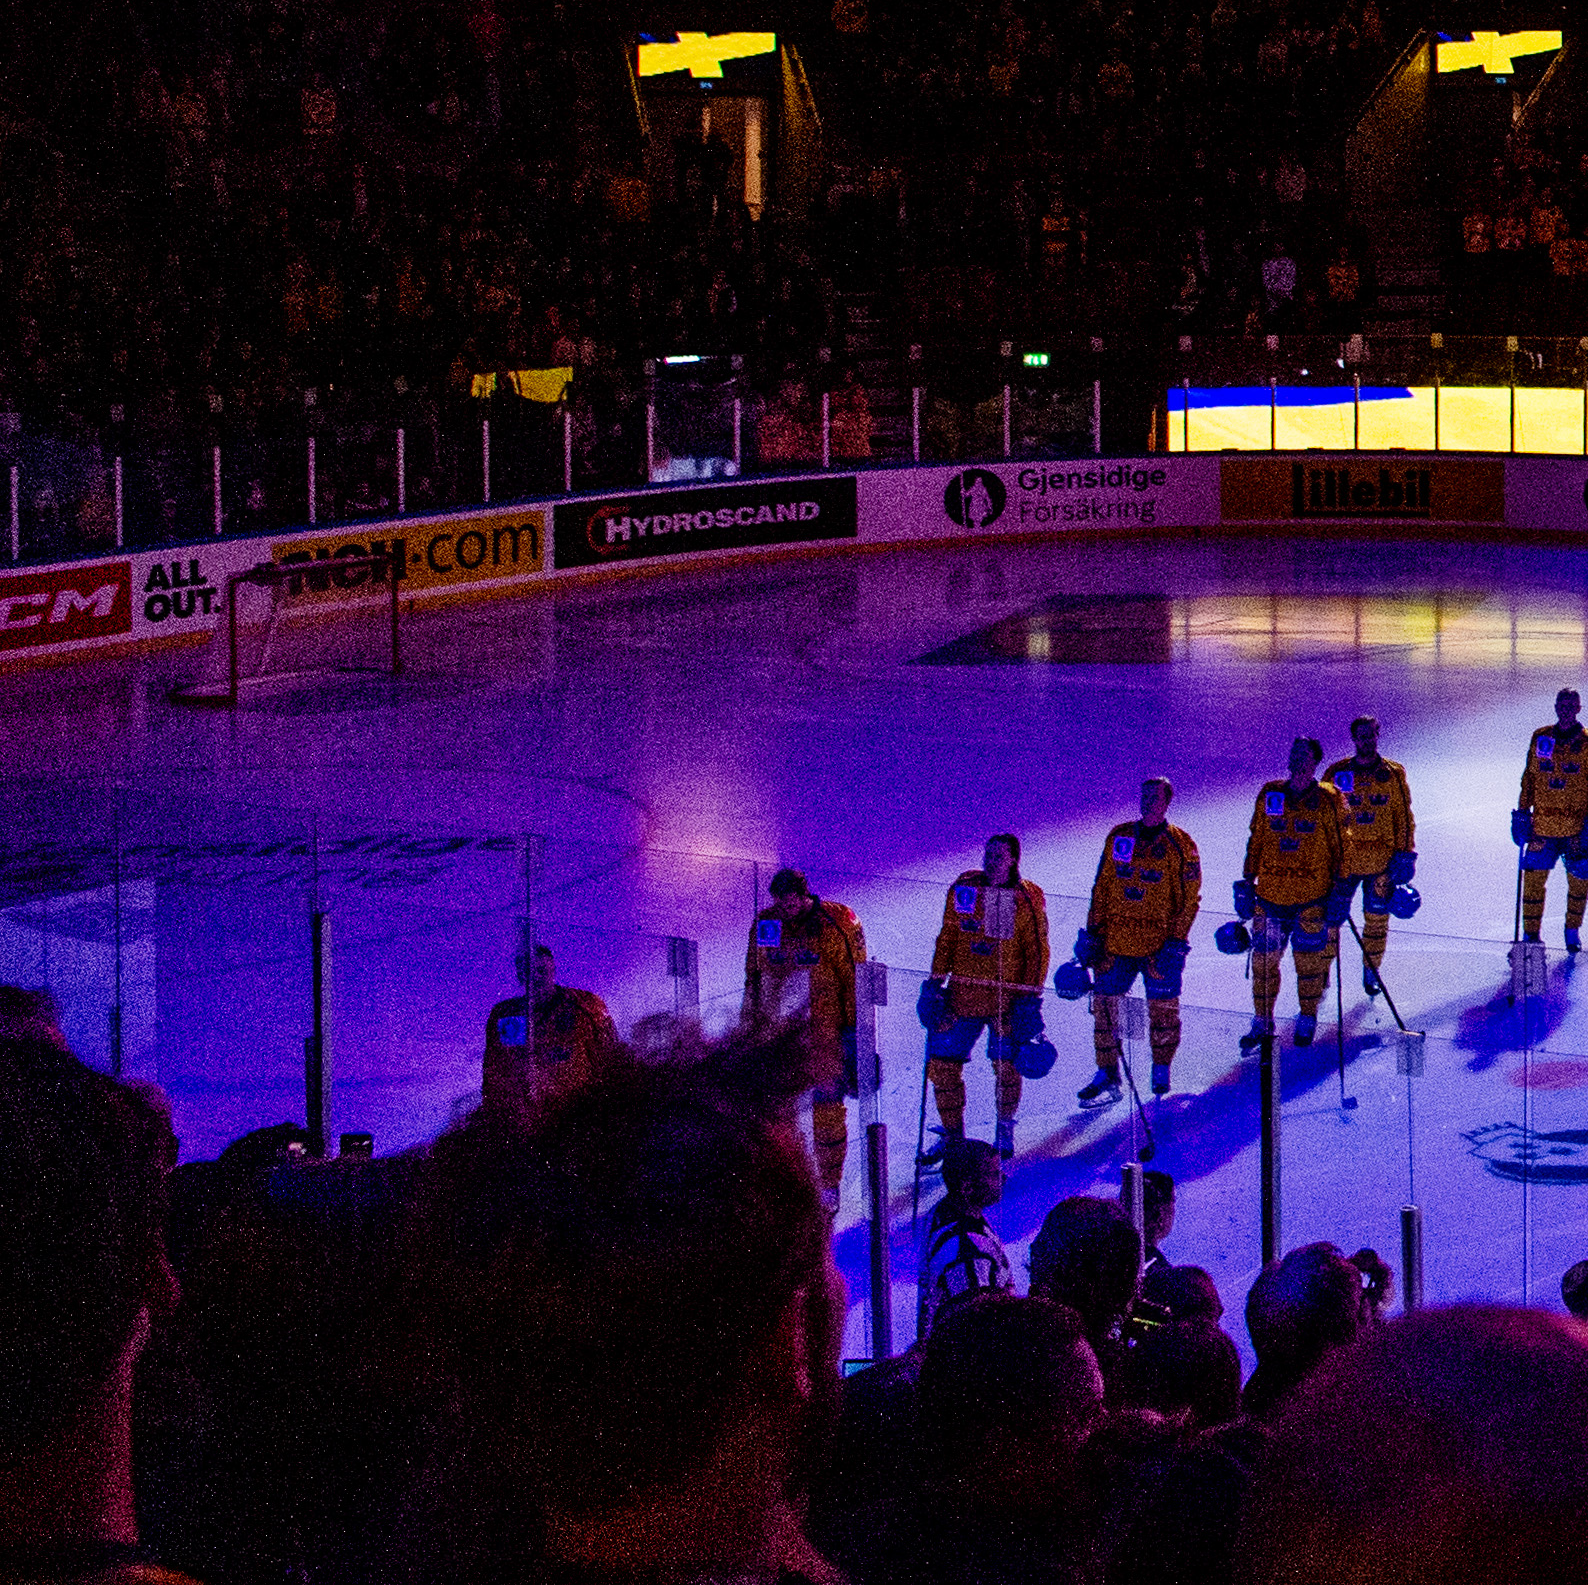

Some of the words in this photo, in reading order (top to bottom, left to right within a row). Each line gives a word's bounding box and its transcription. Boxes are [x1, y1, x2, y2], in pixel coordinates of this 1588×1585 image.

[1017, 466, 1167, 493] Gjensidige
[604, 500, 822, 544] HYDROSCAND
[144, 560, 207, 592] ALL
[145, 588, 221, 622] OUT.
